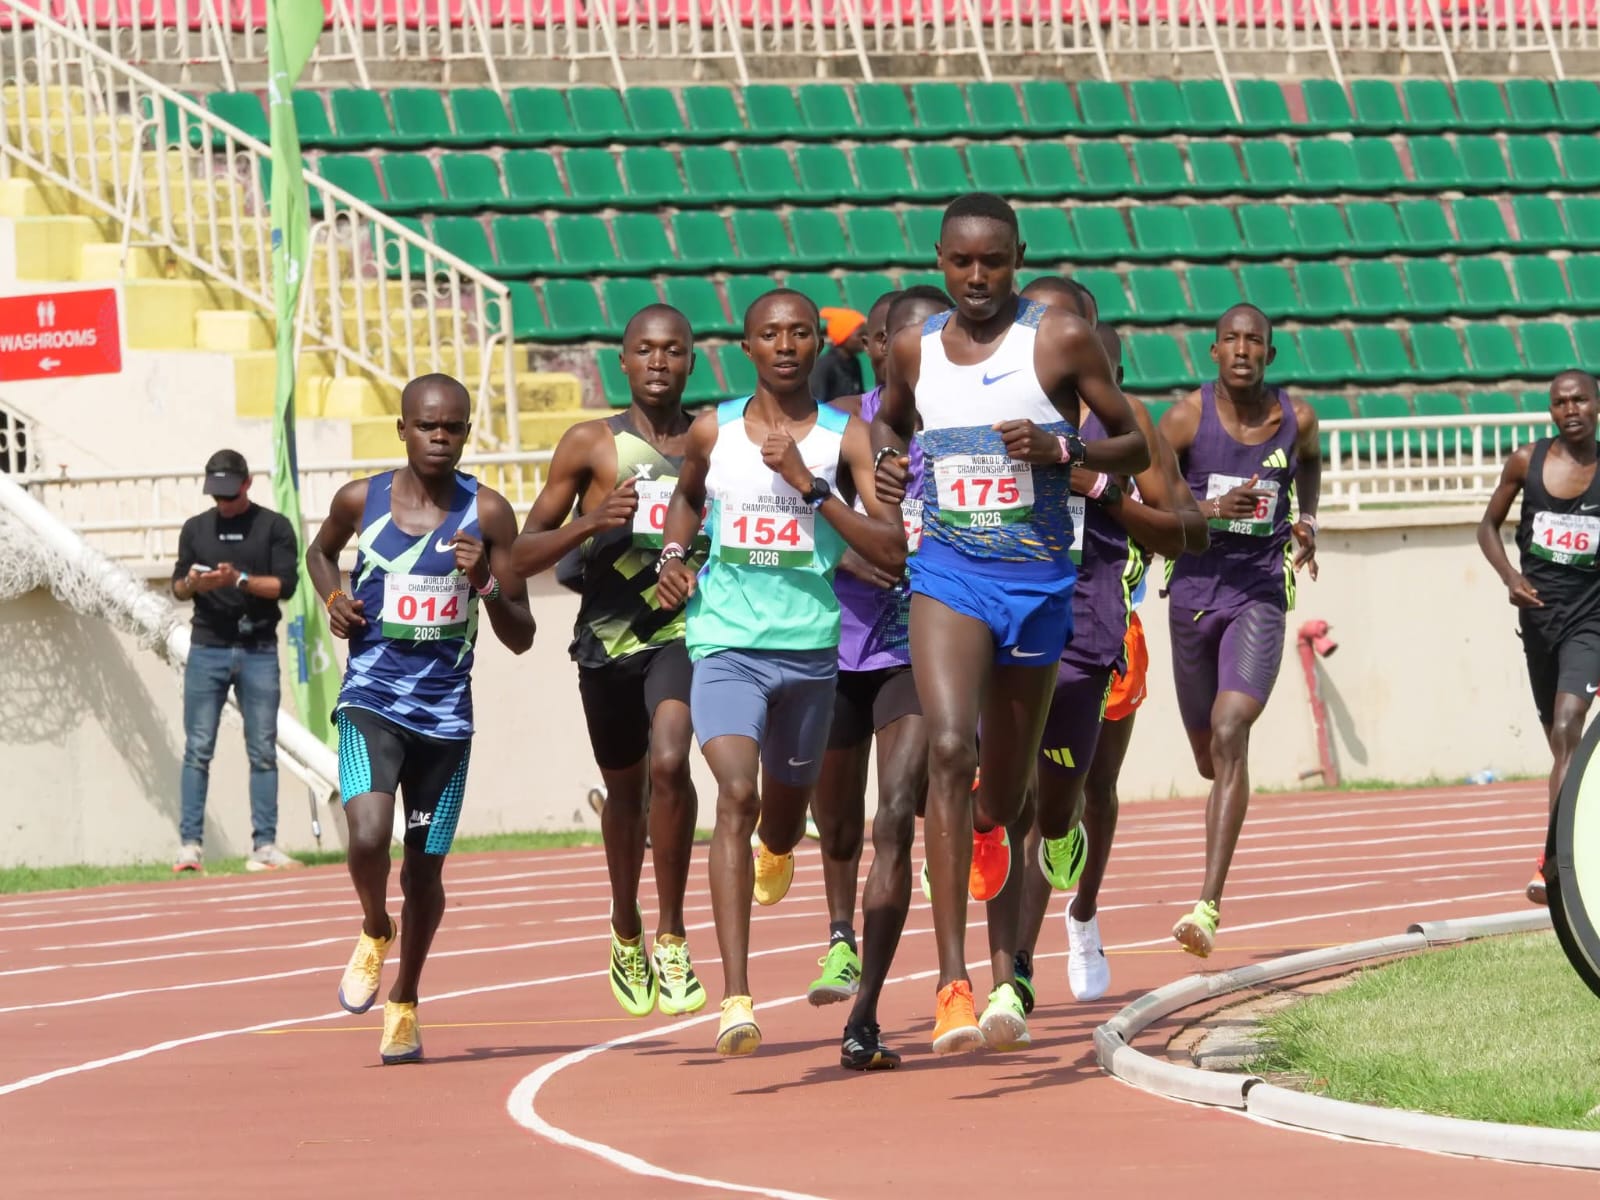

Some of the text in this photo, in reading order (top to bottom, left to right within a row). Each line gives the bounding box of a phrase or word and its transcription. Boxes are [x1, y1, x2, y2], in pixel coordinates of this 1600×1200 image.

[0, 328, 97, 352] WASHROOMS
[971, 456, 994, 464] WORLD
[957, 465, 1005, 474] CHAMPIONSHIP
[1006, 463, 1030, 473] TRIALS
[950, 477, 1020, 507] 175
[758, 495, 797, 505] WORLD U-20
[742, 503, 790, 514] CHAMPIONSHIP
[791, 505, 813, 515] TRIALS
[970, 511, 1002, 527] 2026
[733, 515, 801, 546] 154
[1228, 520, 1253, 535] 2026
[1543, 527, 1590, 552] 146
[749, 550, 779, 566] 2026
[408, 583, 453, 593] CHAMPIONSHIP
[423, 576, 444, 585] WORLD
[398, 595, 459, 622] 014
[414, 627, 441, 640] 2026
